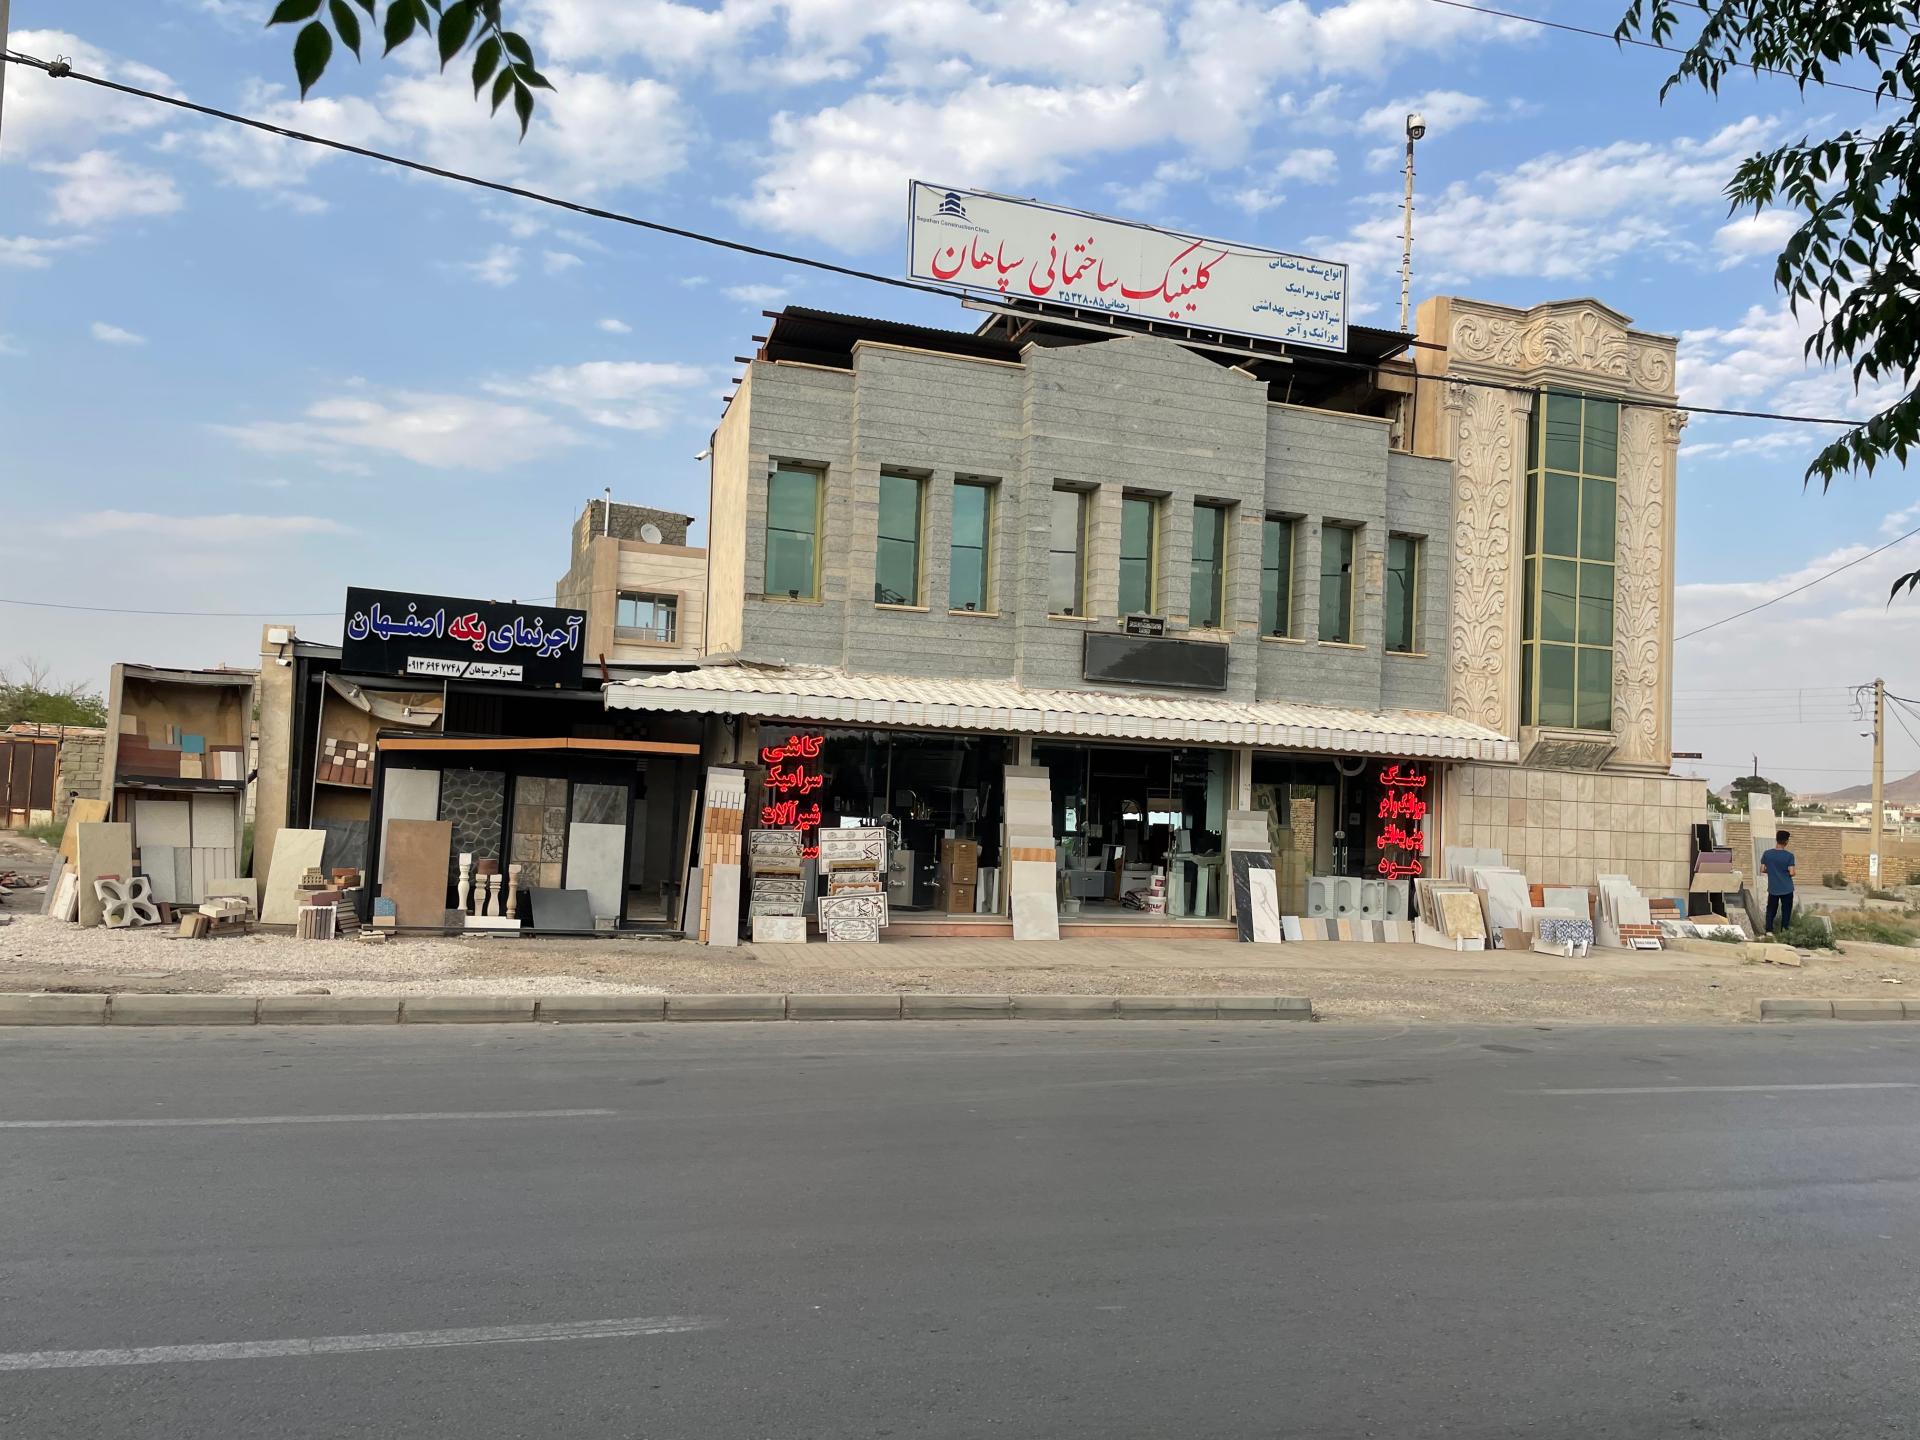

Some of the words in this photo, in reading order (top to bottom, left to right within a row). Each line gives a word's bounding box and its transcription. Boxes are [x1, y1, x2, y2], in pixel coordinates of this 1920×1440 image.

[931, 234, 1024, 293] سپاهان
[1028, 232, 1119, 296] ساختمانی
[1268, 256, 1305, 271] ساختمانی
[1323, 267, 1342, 281] انواع
[1121, 240, 1229, 319] کلینیک
[1285, 283, 1315, 297] سرامیک
[1320, 289, 1341, 301] کاشی
[1252, 300, 1285, 316] بهداشتی
[1285, 306, 1306, 322] چینی
[1286, 322, 1301, 337] آجر
[347, 602, 445, 640] اصفهان
[448, 613, 486, 651] یکه
[469, 665, 491, 677] سپاهان
[490, 666, 503, 677] آجر
[762, 735, 824, 762] کاشی
[763, 764, 823, 795] سرامیک
[1380, 765, 1427, 787] سنگ
[1376, 823, 1407, 850] بهداشتی
[1405, 827, 1425, 853] چینی
[1377, 857, 1423, 880] هود
